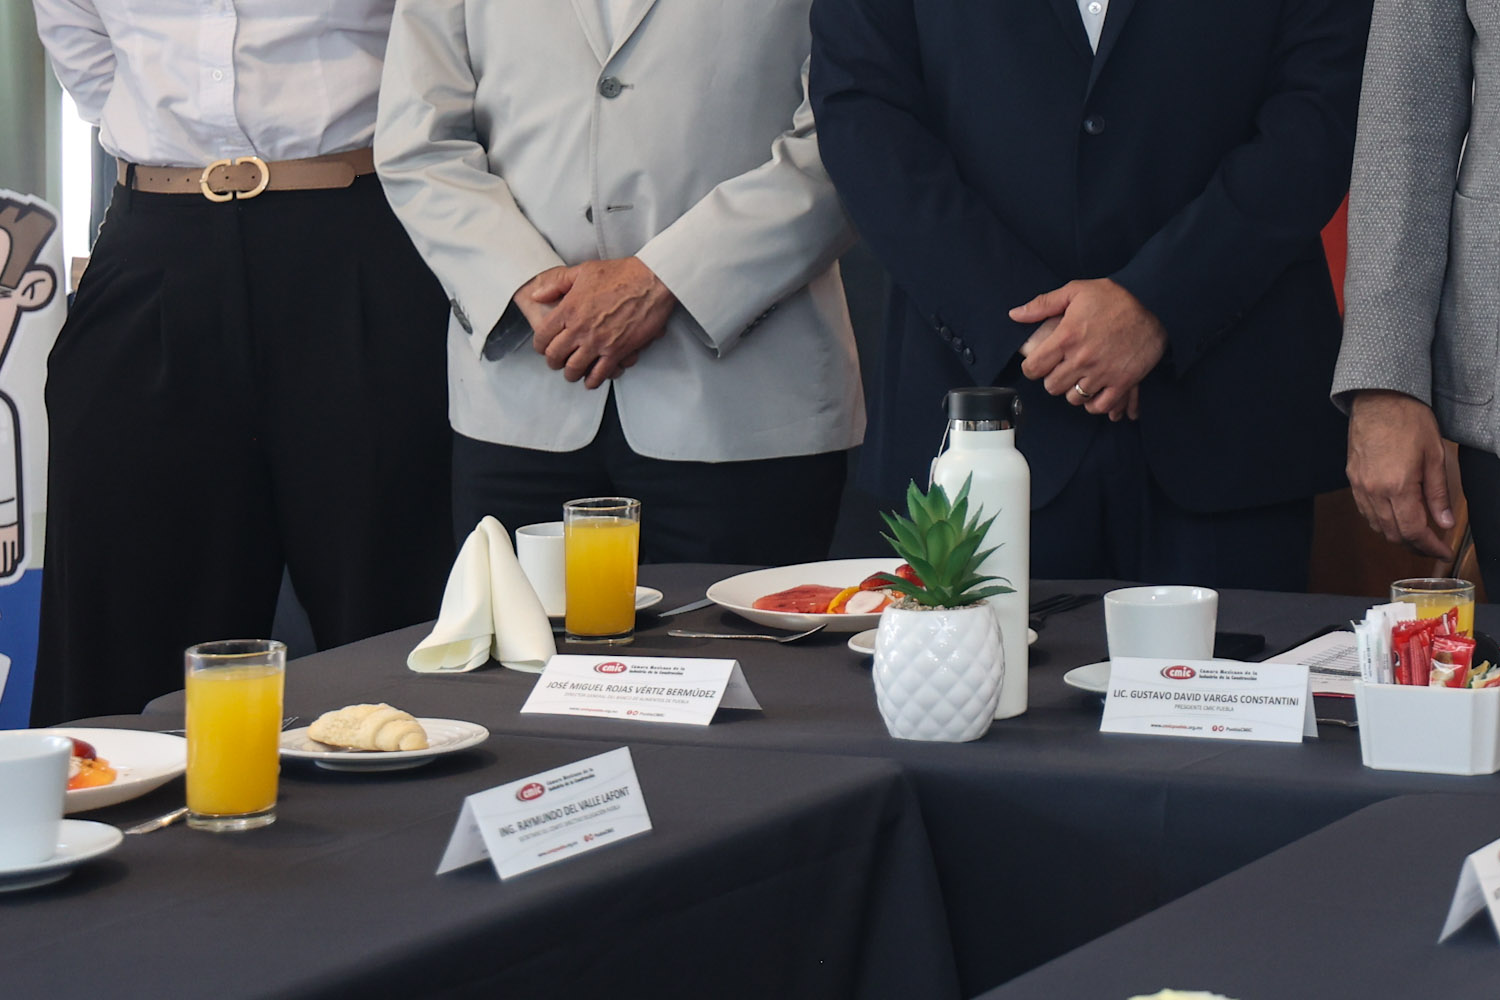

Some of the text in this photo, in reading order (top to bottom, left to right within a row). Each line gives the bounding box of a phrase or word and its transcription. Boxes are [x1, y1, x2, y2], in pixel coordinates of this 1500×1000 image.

[602, 662, 624, 673] cmic
[1169, 665, 1192, 677] cmic
[546, 680, 717, 699] JOSÉ MIGUEL ROJAS VÉRTIZ BERMÚDEZ
[1113, 689, 1299, 706] LIC. GUSTAVO DAVID VARGAS CONSTANTINI
[499, 825, 516, 837] ING.
[517, 809, 563, 830] RAYMUNDO
[564, 804, 579, 816] DEL
[579, 795, 600, 810] VALLE
[601, 786, 630, 803] LAFONT
